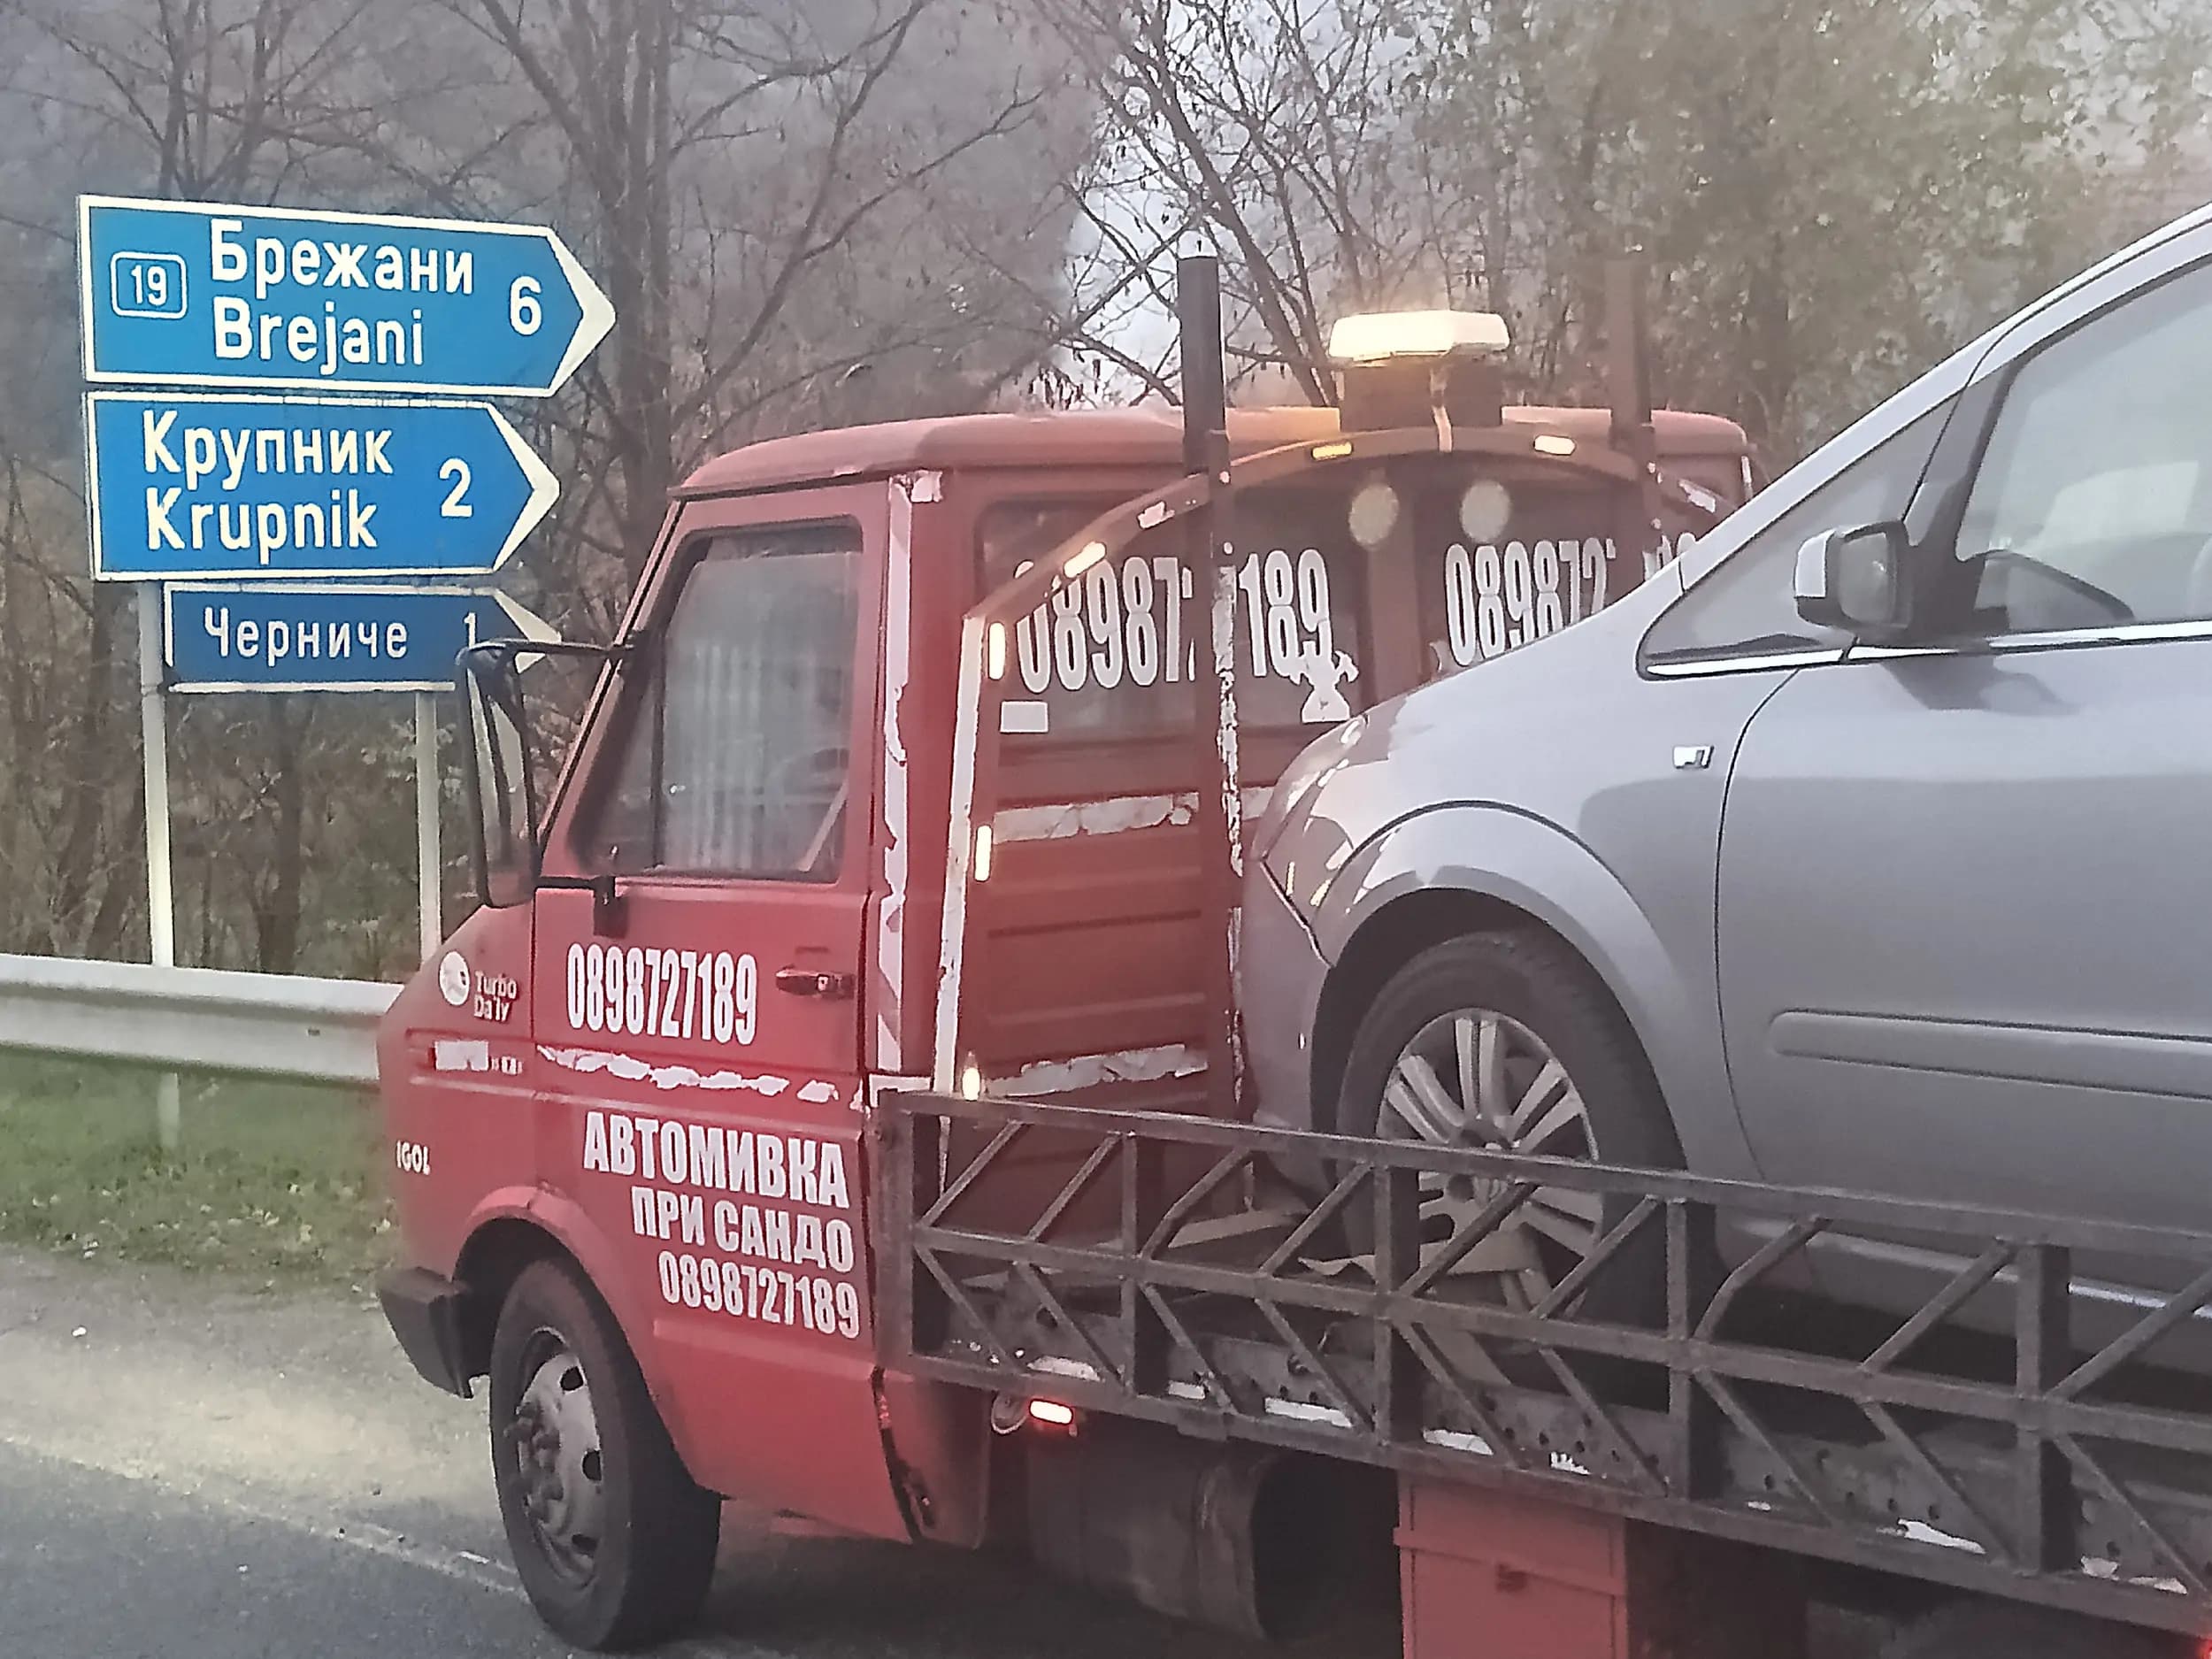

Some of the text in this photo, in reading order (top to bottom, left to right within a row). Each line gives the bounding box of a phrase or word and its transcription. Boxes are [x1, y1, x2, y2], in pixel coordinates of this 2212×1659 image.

[130, 265, 168, 307] 19
[210, 218, 474, 299] Брежани
[213, 296, 425, 375] Brejani
[509, 276, 543, 336] 6
[142, 409, 394, 490] Крупник
[439, 457, 473, 518] 2
[145, 487, 378, 565] Krupnik
[203, 606, 410, 667] Черниче
[464, 611, 477, 649] 1
[1016, 547, 1336, 694] 08987189
[474, 970, 518, 1000] Turbo
[474, 994, 511, 1023] Daily
[567, 942, 758, 1046] 0898727189
[396, 1139, 432, 1176] IGOL
[583, 1110, 850, 1210] АВТОМИВКА
[631, 1185, 856, 1274] ПРИ САНДО
[658, 1249, 861, 1340] 0898727189
